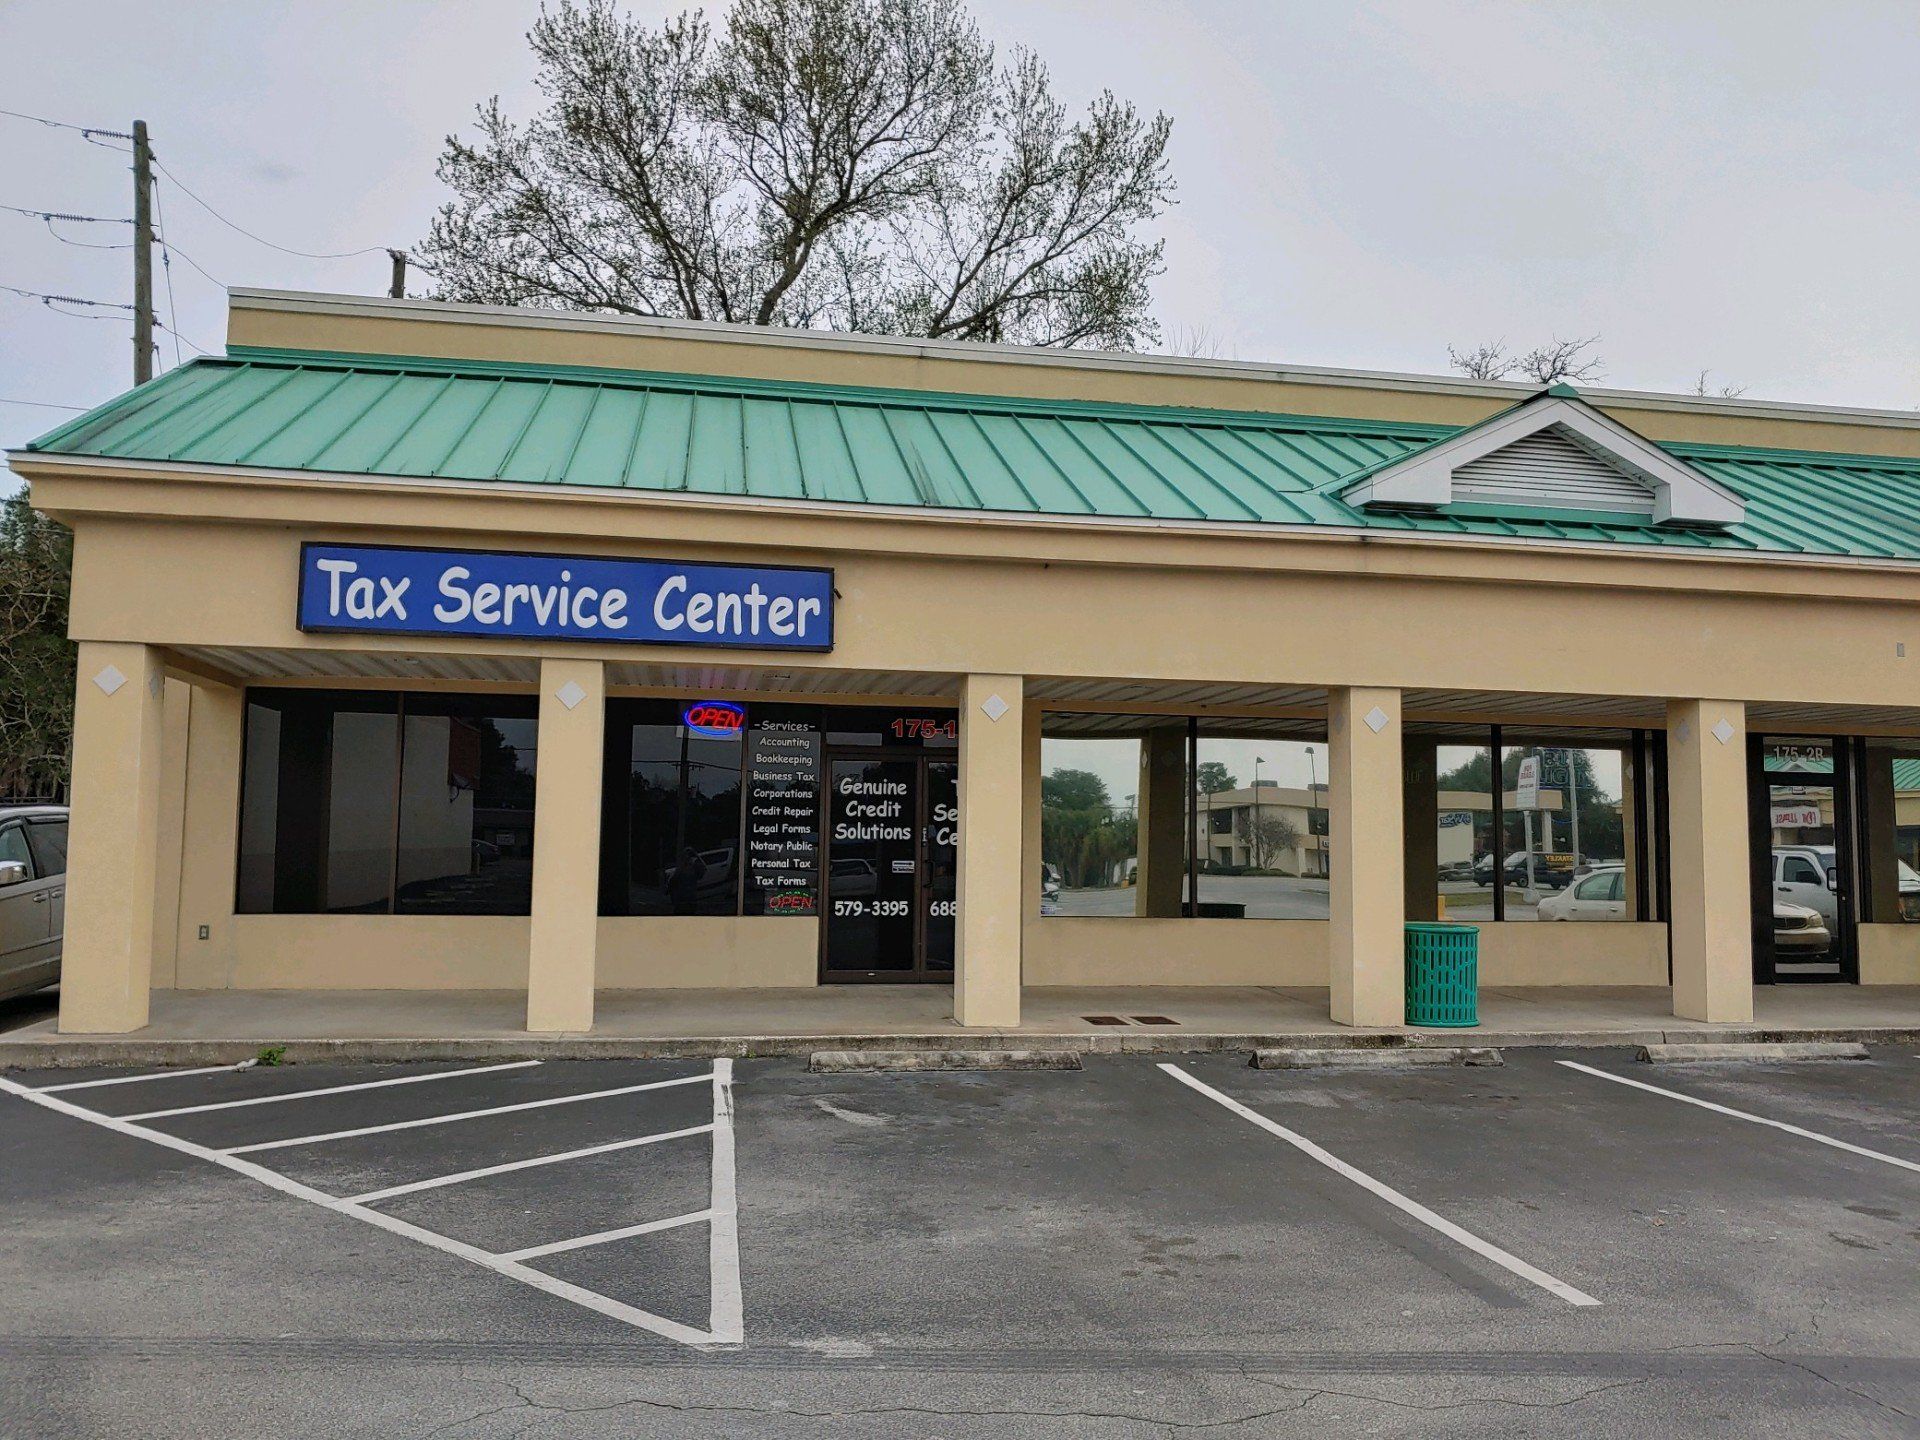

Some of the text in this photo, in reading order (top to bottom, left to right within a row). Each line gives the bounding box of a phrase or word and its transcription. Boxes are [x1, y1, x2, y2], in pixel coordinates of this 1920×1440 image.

[316, 558, 821, 637] Tax Service Center
[688, 707, 744, 731] OPEN
[891, 718, 956, 739] 175-1
[759, 737, 810, 749] Accounting
[755, 754, 813, 766] Bookkeeping
[753, 771, 814, 782] Business Tax
[839, 777, 907, 796] Genuine
[753, 789, 813, 800] Corporations
[752, 806, 813, 818] Credit Repair
[845, 801, 902, 818] Credit
[753, 824, 811, 835] Legal Forms
[834, 822, 912, 840] Solutions
[750, 841, 813, 852] Notary Public
[751, 859, 811, 868] Personal Tax
[755, 876, 807, 886] Tax Forms
[769, 895, 814, 909] OPEN
[834, 900, 909, 917] 579-3395
